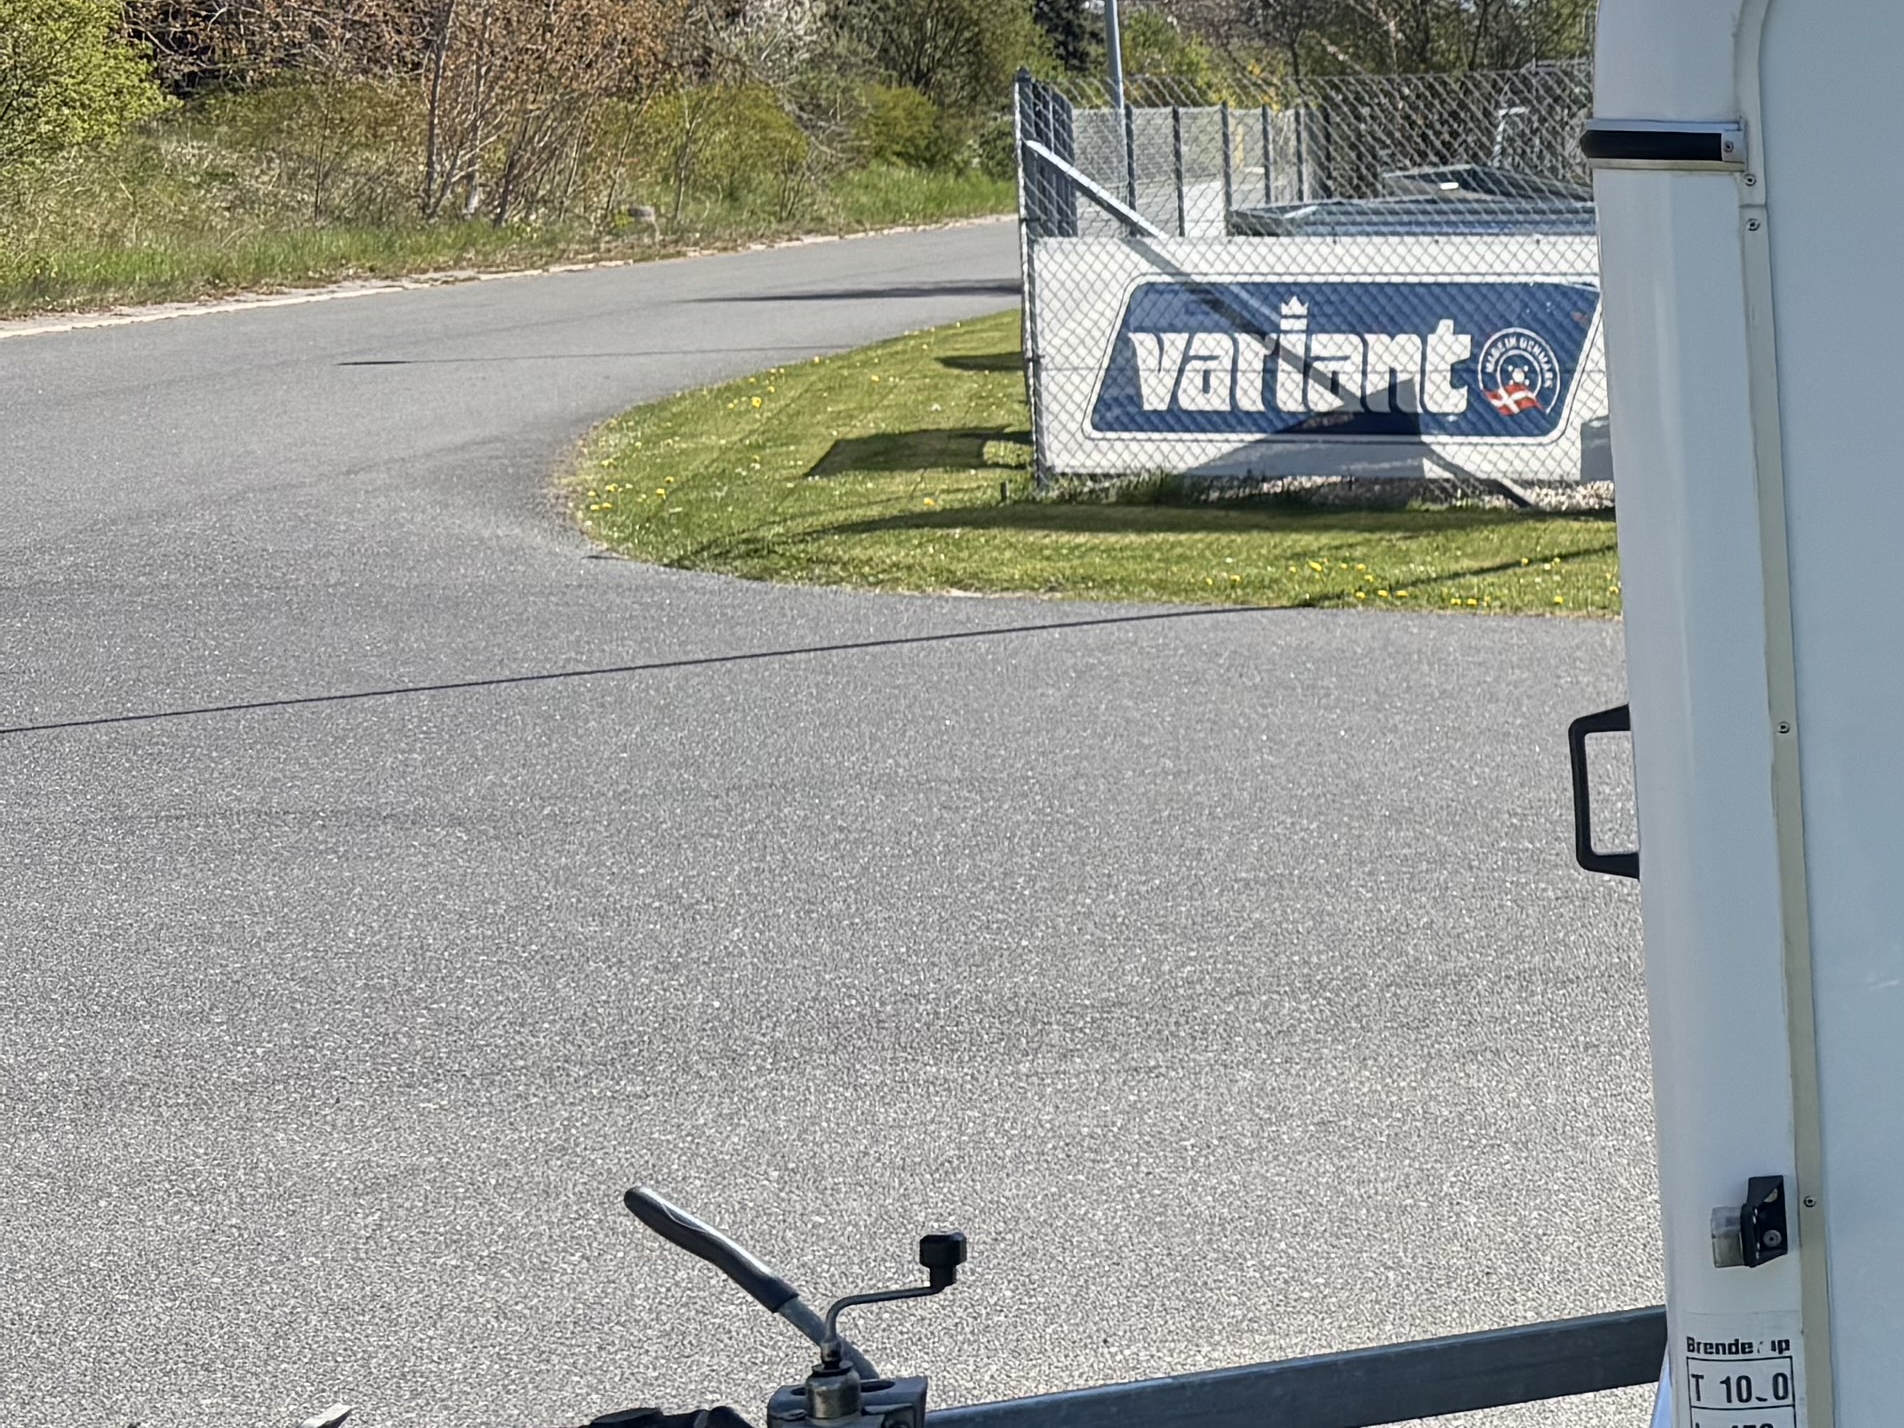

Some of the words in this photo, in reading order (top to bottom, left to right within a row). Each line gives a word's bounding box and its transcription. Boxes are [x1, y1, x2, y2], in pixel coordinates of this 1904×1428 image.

[1128, 317, 1471, 414] variant
[1691, 1373, 1705, 1402] T
[1720, 1372, 1789, 1404] 100
